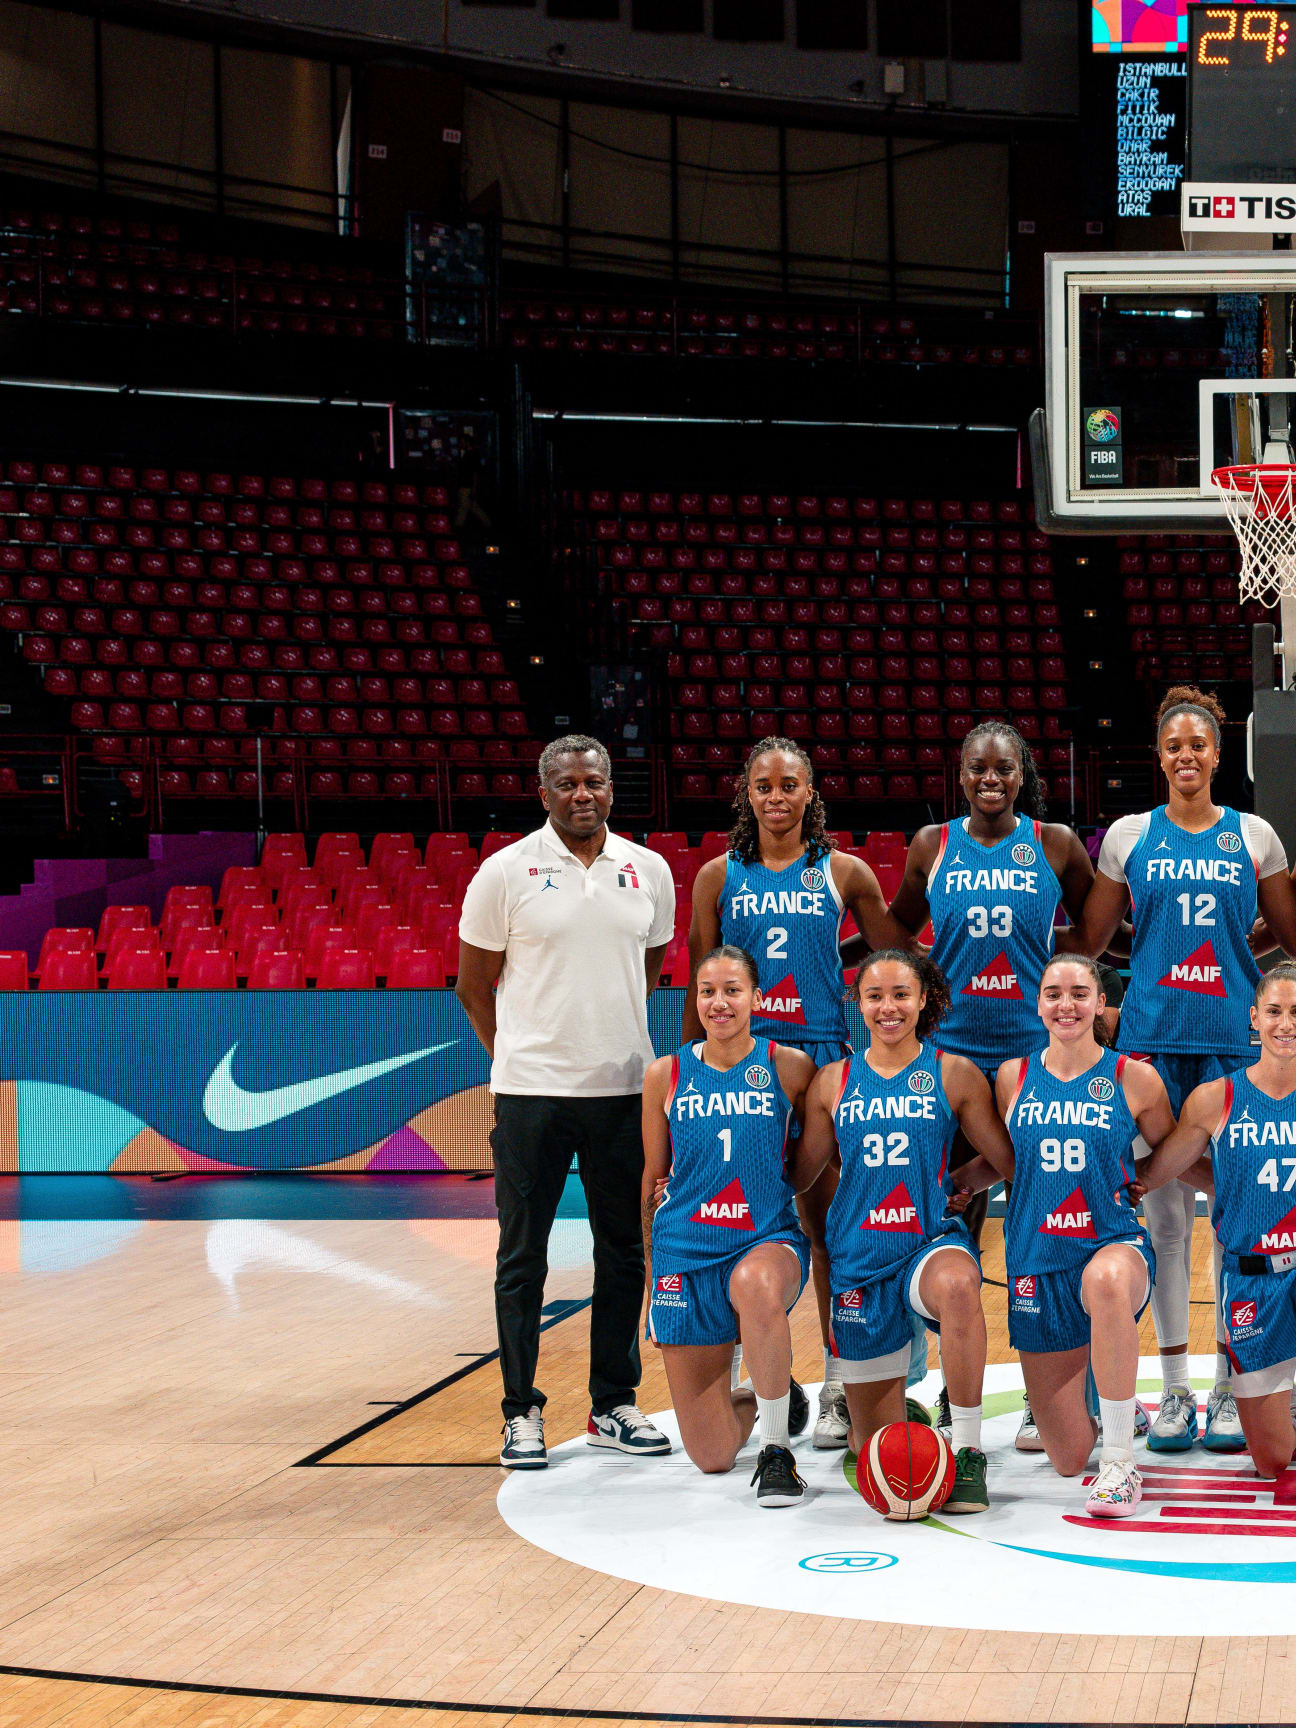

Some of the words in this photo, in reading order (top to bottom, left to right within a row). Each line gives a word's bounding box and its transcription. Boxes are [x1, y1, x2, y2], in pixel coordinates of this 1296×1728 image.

[1117, 76, 1151, 88] UZUN
[1118, 88, 1159, 101] CAKIR
[1117, 101, 1159, 114] FITIK
[1118, 126, 1167, 139] BILGIC
[1118, 140, 1151, 152] ONAR
[1118, 152, 1168, 165] BAYRAM
[1118, 165, 1184, 178] SENYUREK
[1118, 178, 1176, 190] ERDOGAN
[1118, 191, 1152, 203] ATAS
[1118, 203, 1151, 216] URAL
[1091, 451, 1116, 464] FIBA
[1146, 858, 1243, 886] FRANCE
[945, 868, 1038, 894] FRANCE
[731, 890, 826, 921] FRANCE
[1176, 893, 1217, 926] 12
[966, 905, 1013, 938] 33
[766, 927, 788, 959] 2
[1171, 964, 1222, 982] MAIF
[971, 974, 1017, 991] MAIF
[760, 997, 802, 1013] MAIF
[676, 1092, 775, 1121] FRANCE
[839, 1095, 937, 1127] FRANCE
[1017, 1101, 1114, 1130] FRANCE
[717, 1128, 732, 1162] 1
[862, 1131, 910, 1168] 32
[1039, 1138, 1086, 1173] 98
[700, 1202, 750, 1219] MAIF
[869, 1206, 917, 1225] MAIF
[1046, 1211, 1092, 1229] MAIF
[838, 1309, 860, 1317] CAISSE
[1233, 1326, 1253, 1335] CAISSE
